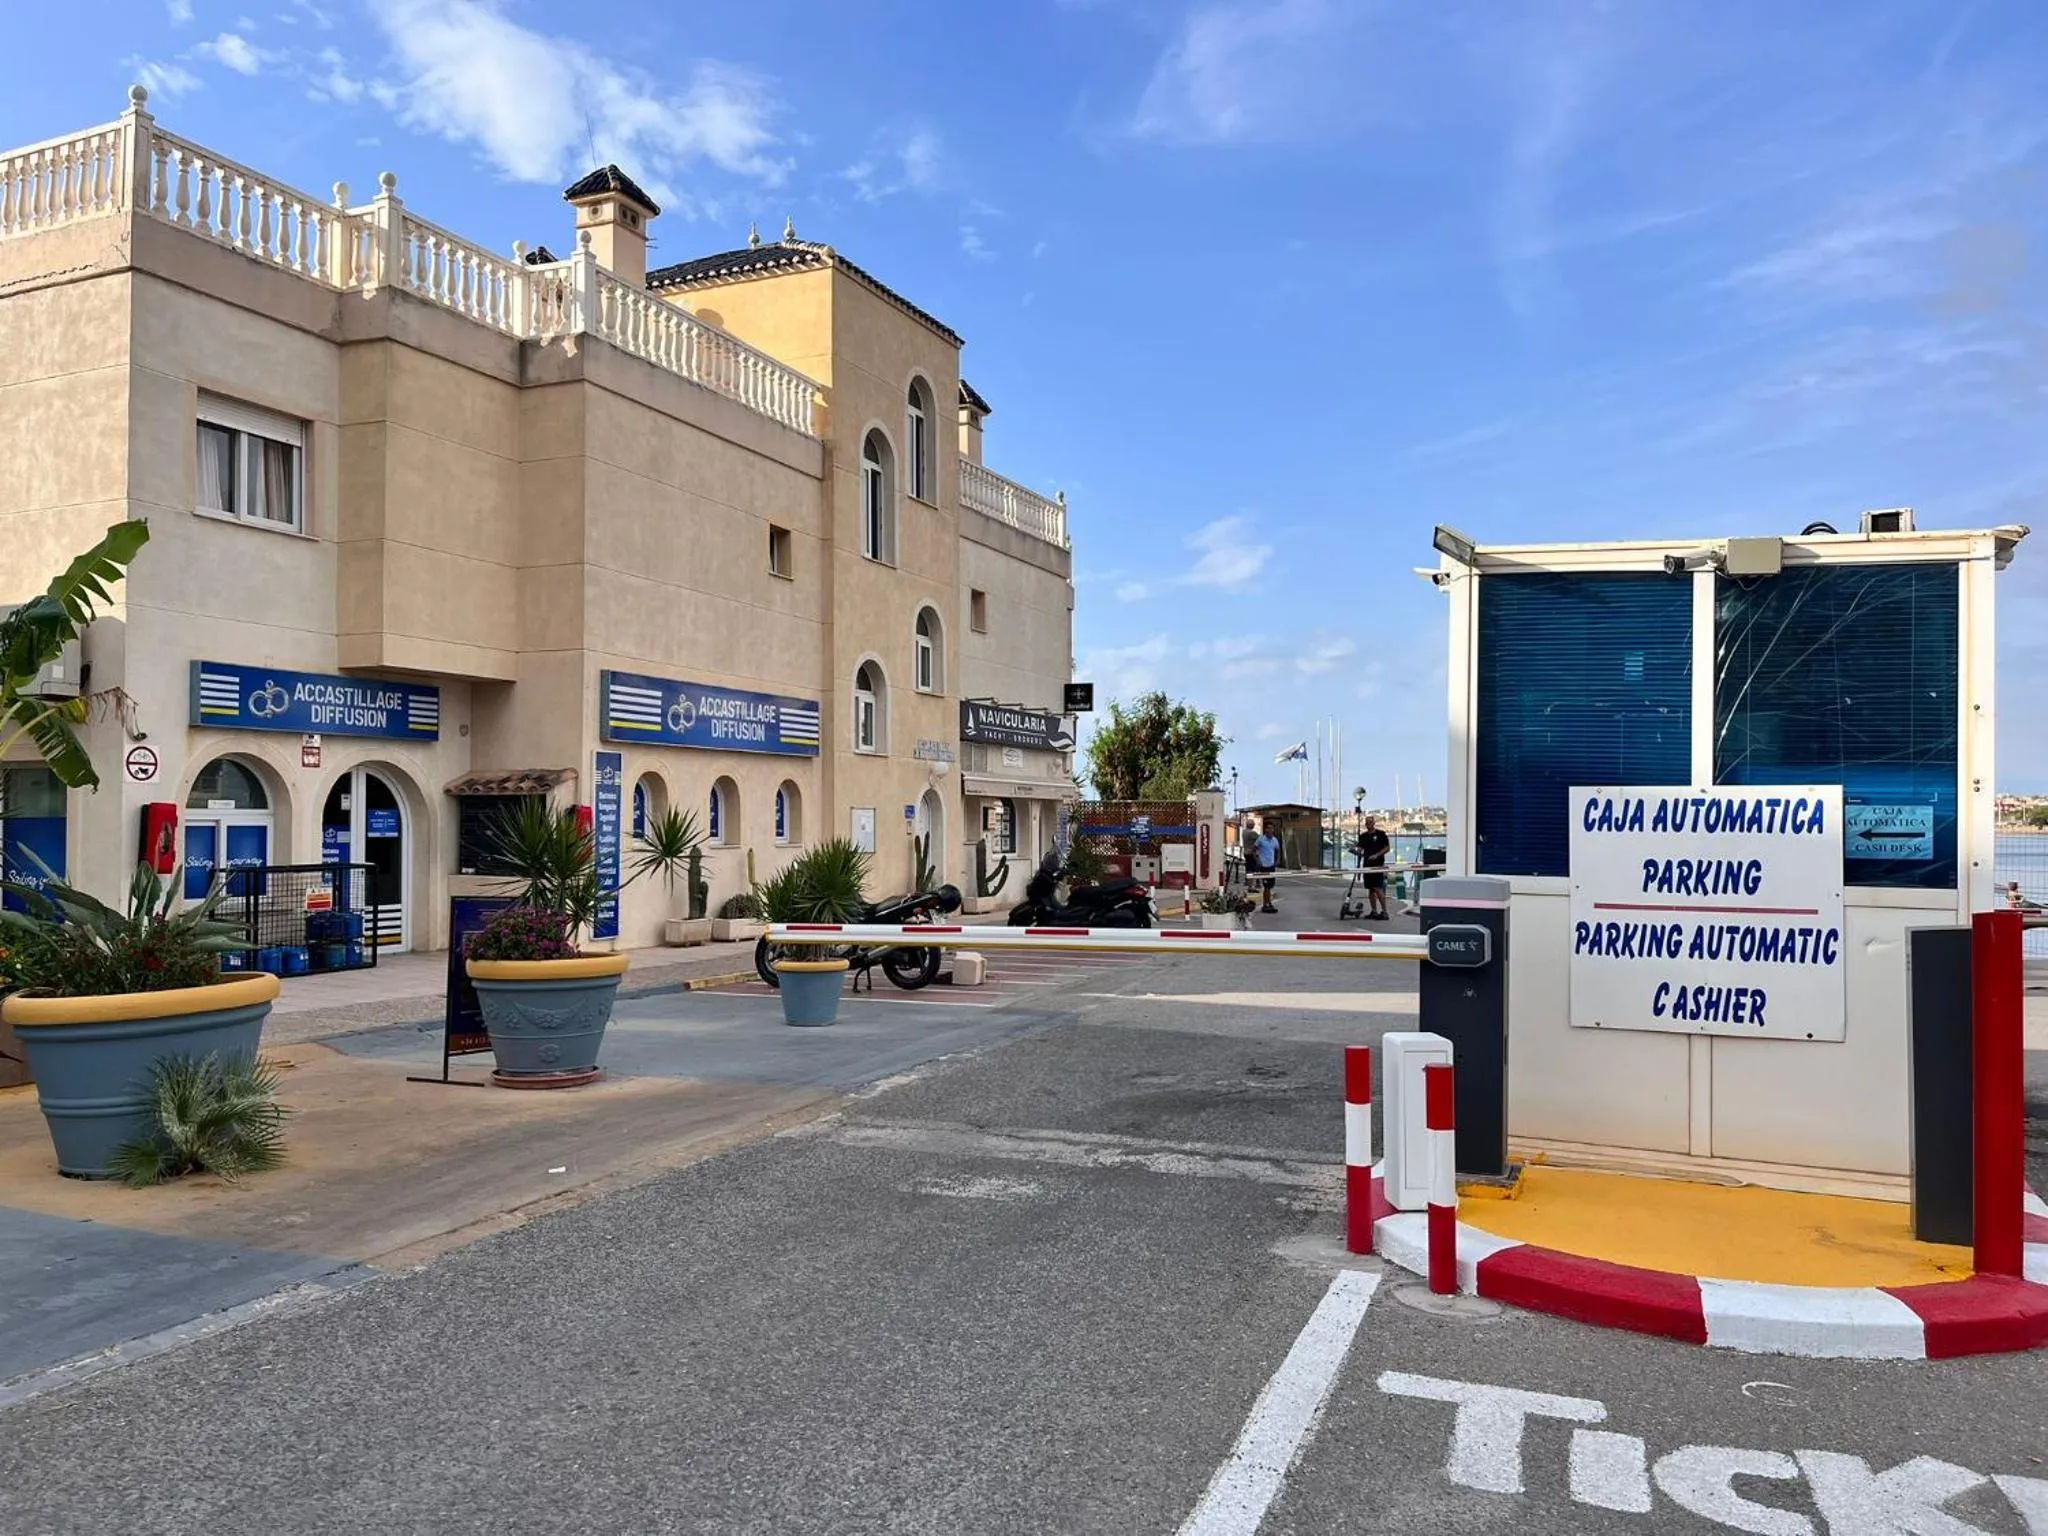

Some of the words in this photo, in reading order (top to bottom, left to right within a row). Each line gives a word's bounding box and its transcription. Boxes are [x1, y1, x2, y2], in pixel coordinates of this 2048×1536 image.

[294, 682, 402, 710] ACCASTILLAGE
[311, 705, 387, 728] DIFFUSION
[699, 696, 777, 723] ACCASTILLAGE
[978, 708, 1047, 732] NAVICULARIA
[711, 720, 765, 742] DIFFUSION
[1583, 797, 1644, 832] CAJA
[1651, 797, 1824, 834] AUTOMATICA
[1873, 807, 1903, 816] CAJA
[1855, 844, 1887, 853] CASH
[1890, 844, 1922, 853] DESK
[1642, 858, 1762, 897] PARKING
[1436, 941, 1466, 951] CAME
[1574, 921, 1683, 959] PARKING
[1688, 925, 1839, 965] AUTOMATIC
[1652, 981, 1767, 1027] CASHIER
